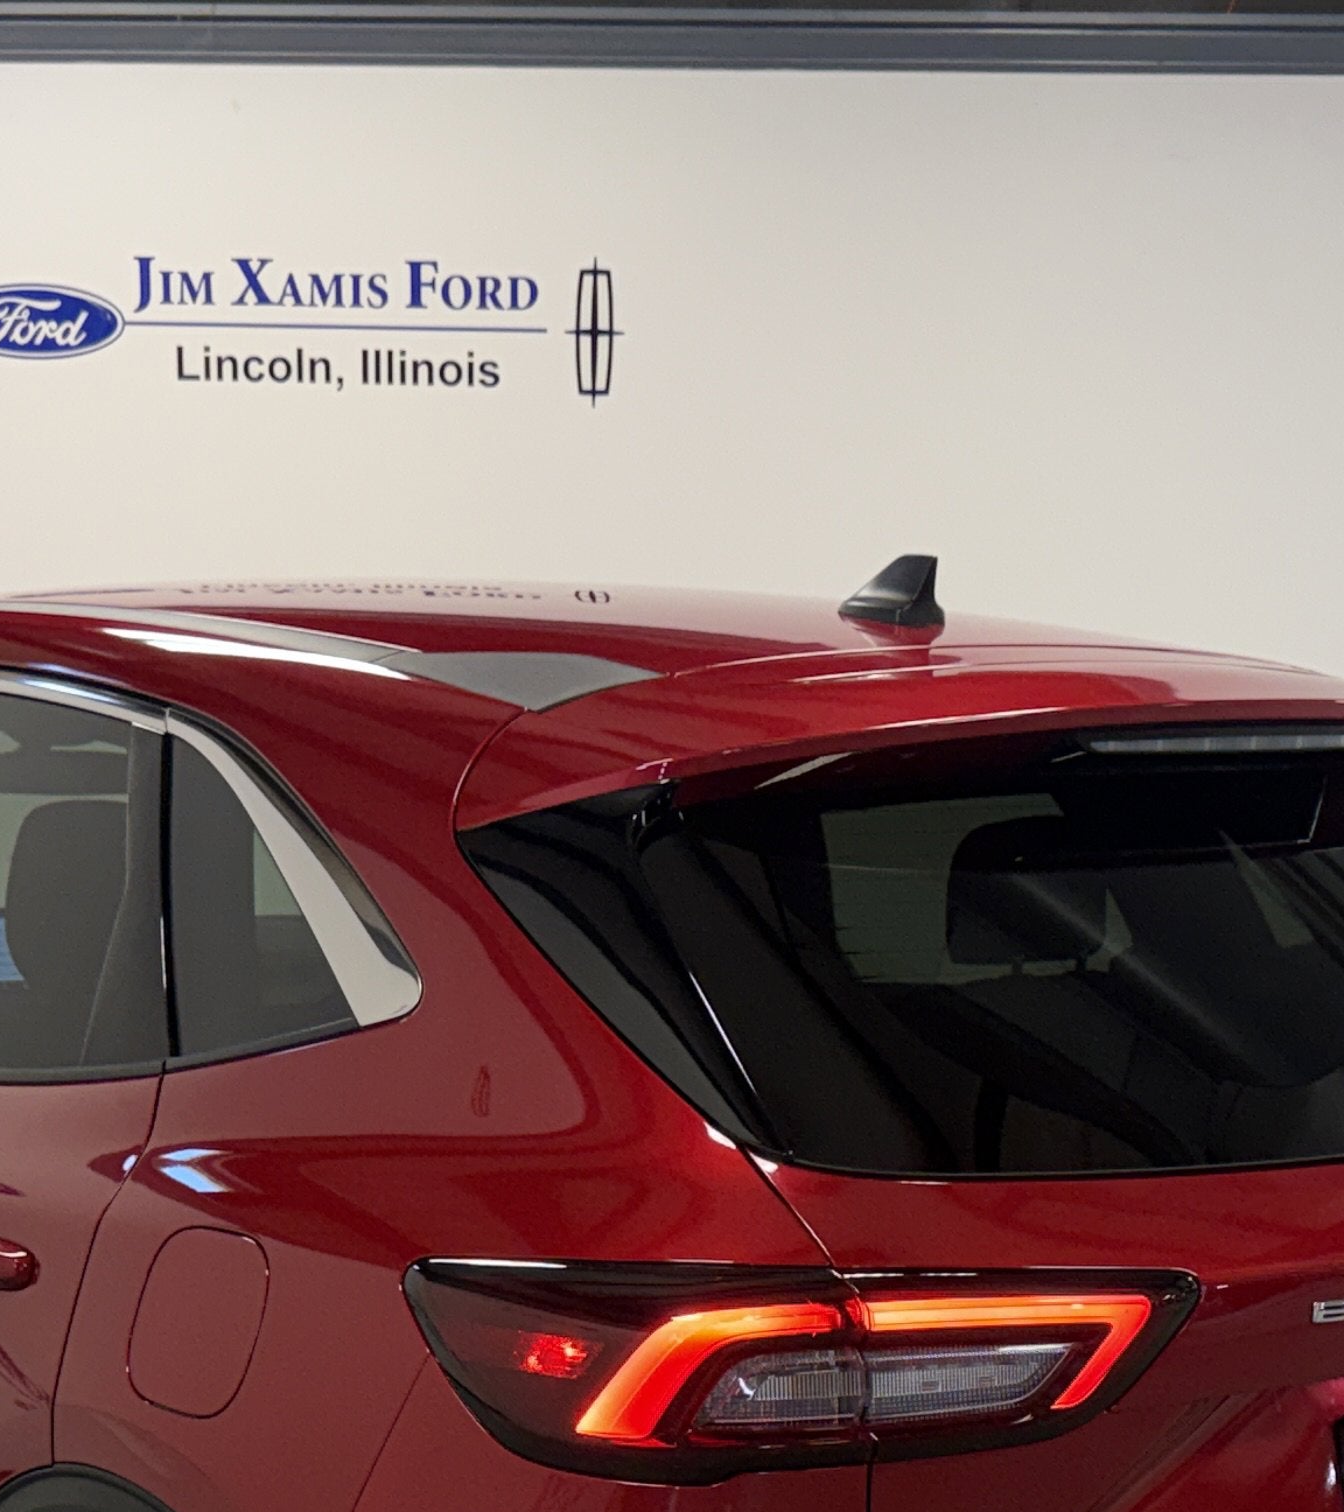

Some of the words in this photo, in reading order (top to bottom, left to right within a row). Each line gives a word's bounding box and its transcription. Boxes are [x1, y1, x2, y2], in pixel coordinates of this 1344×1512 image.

[134, 256, 215, 314] JIM
[231, 257, 389, 310] XAMIS
[406, 261, 539, 311] FORD
[176, 346, 344, 392] Lincoln,
[361, 350, 501, 388] Illinois
